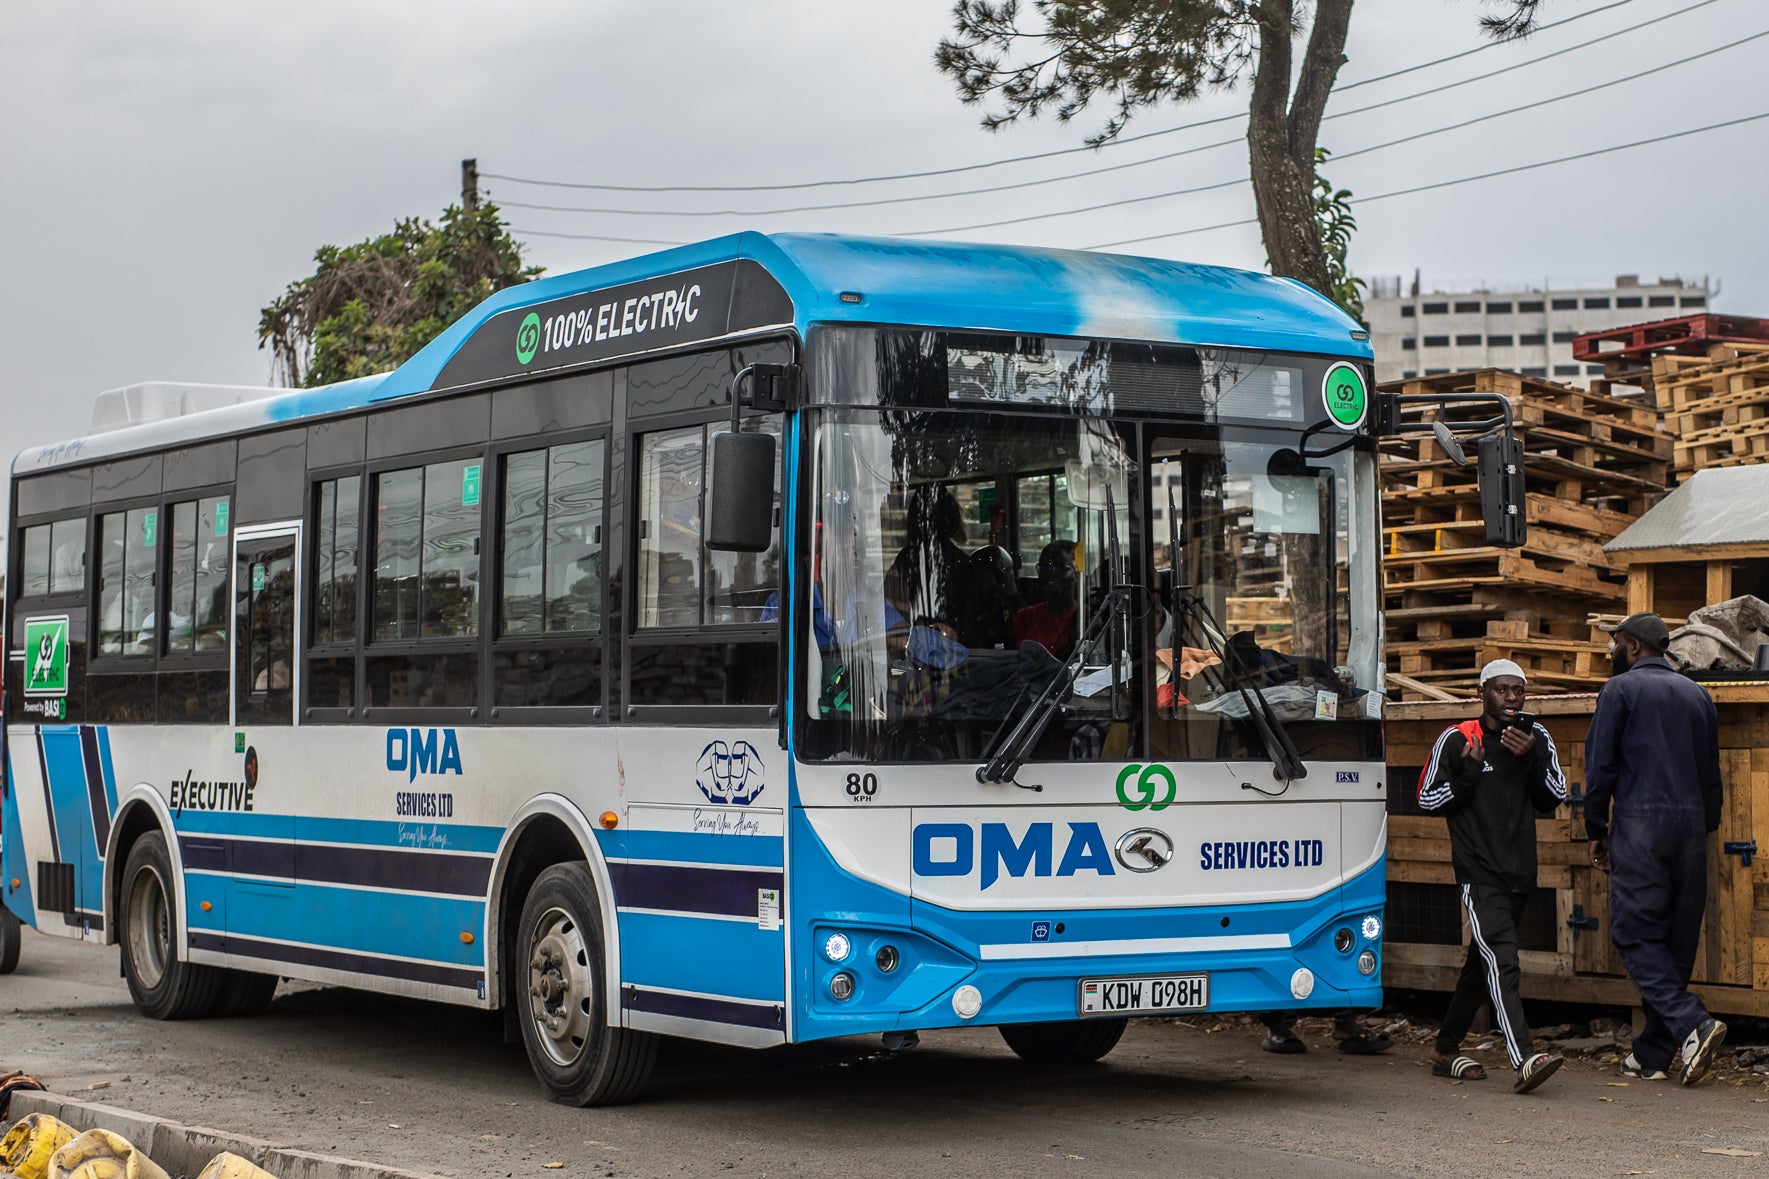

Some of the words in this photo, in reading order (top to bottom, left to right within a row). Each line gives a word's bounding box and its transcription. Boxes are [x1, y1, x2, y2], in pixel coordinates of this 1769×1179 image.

[543, 307, 593, 353] 100%
[595, 282, 701, 342] ELECTRIC
[1334, 402, 1359, 411] ELECTRIC
[386, 728, 463, 785] OMA
[169, 769, 254, 819] EXECUTIVE
[846, 773, 877, 795] 80
[396, 791, 437, 817] SERVICES
[438, 793, 453, 818] LTD
[912, 821, 1116, 892] OMA
[1200, 840, 1290, 871] SERVICES
[1294, 839, 1323, 867] LTD
[1102, 982, 1142, 1010] KDW
[1151, 979, 1202, 1008] 098H
